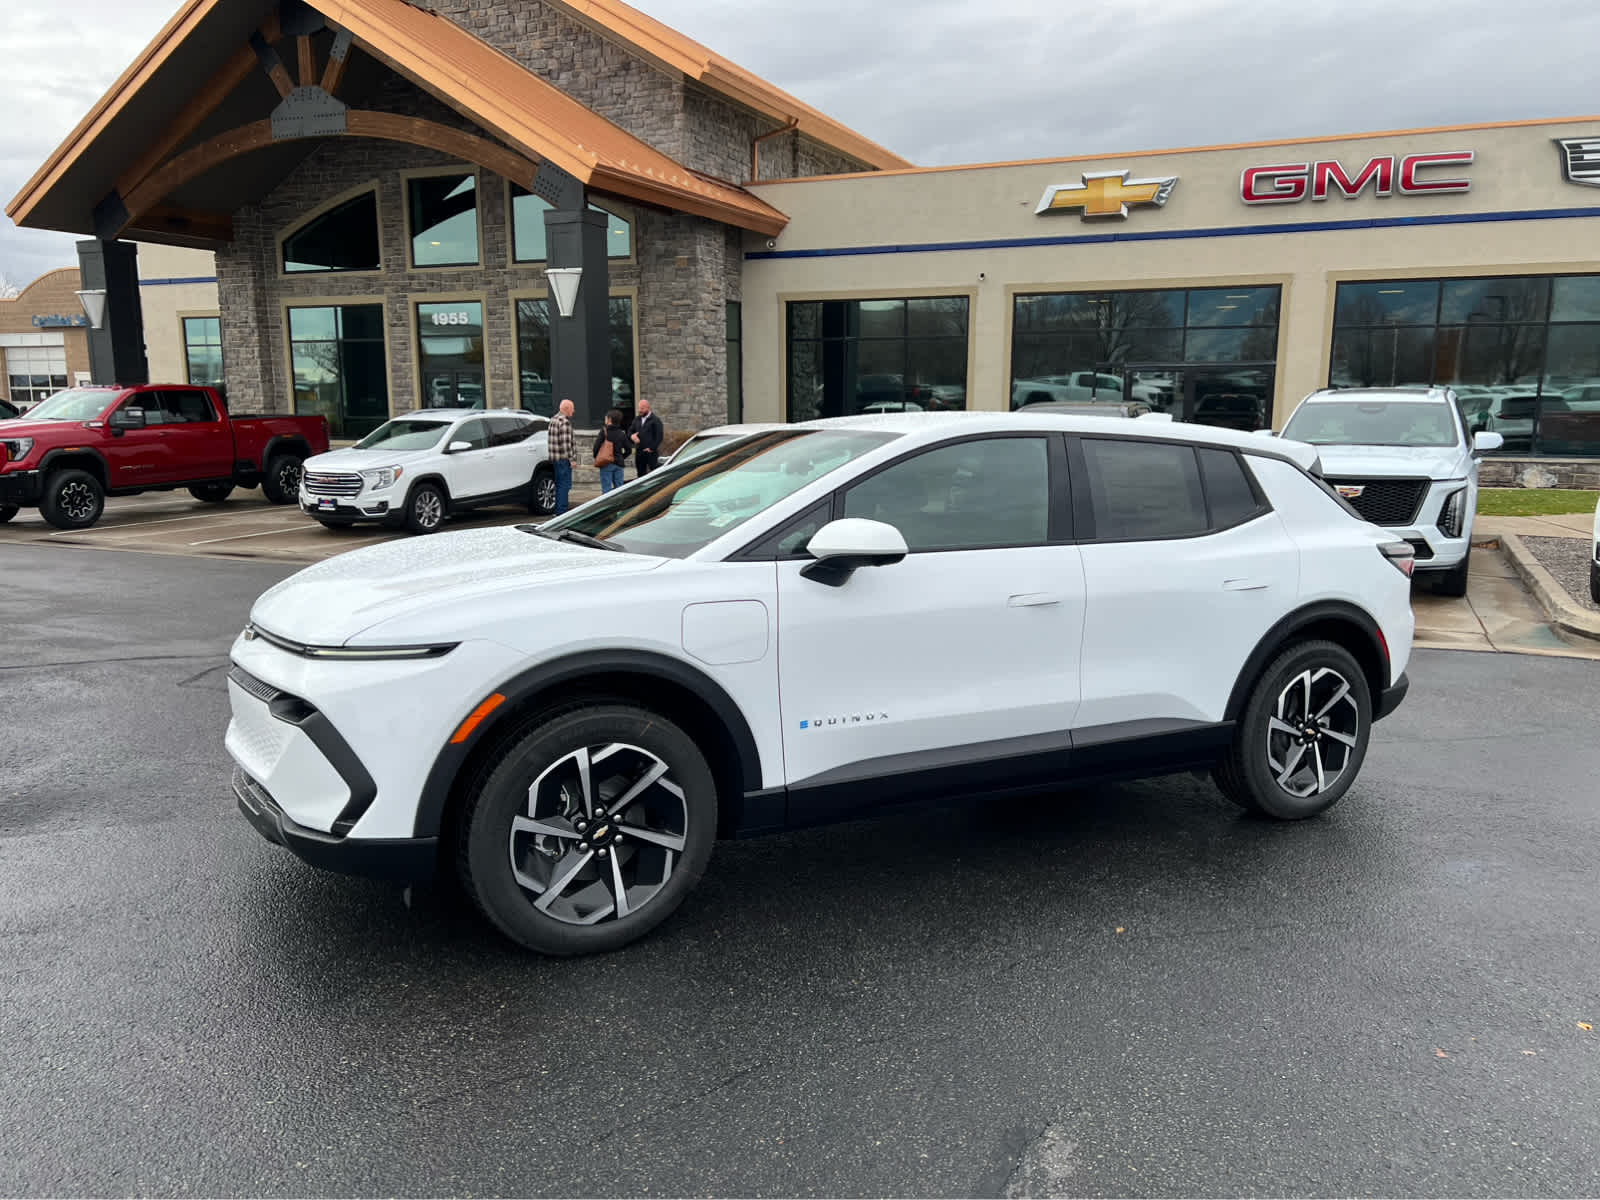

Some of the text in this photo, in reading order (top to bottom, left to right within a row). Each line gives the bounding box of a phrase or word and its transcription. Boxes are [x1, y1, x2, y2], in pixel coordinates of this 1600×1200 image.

[1240, 150, 1474, 204] GMC
[432, 312, 468, 325] 1955
[799, 712, 889, 730] EQUINOX
